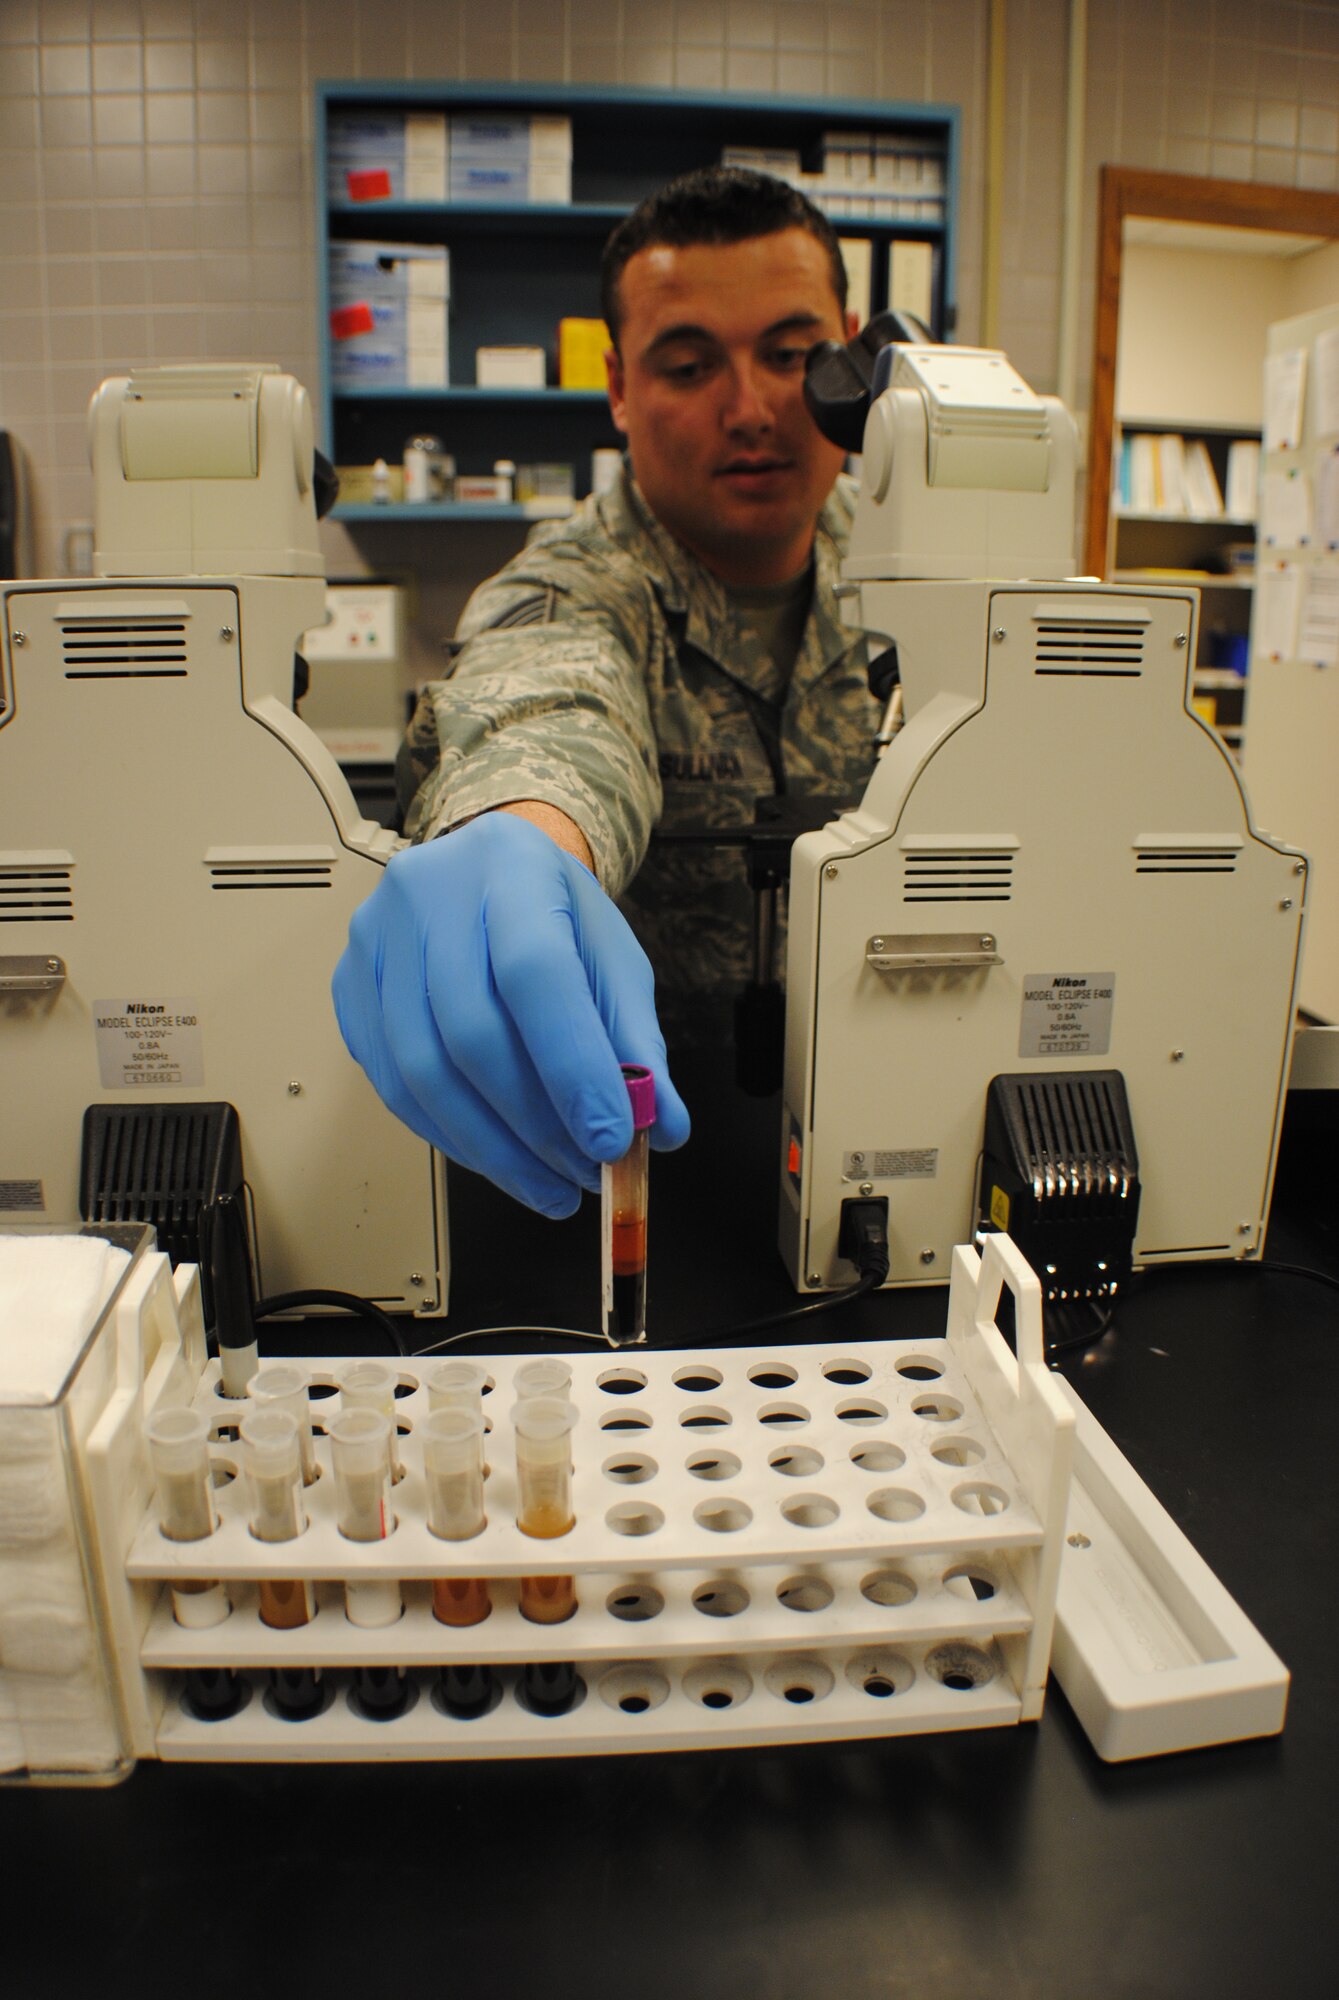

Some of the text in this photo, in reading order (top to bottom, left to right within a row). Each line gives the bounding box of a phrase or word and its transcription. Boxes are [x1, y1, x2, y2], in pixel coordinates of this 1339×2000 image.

[1052, 978, 1087, 987] Nikon
[1025, 989, 1112, 1001] MODEL ECLIPSE E400
[126, 1004, 165, 1014] Nikon
[97, 1015, 197, 1028] MODEL ECLIPSE E400
[138, 1041, 160, 1050] 0.8A
[132, 1053, 168, 1061] 50/60Hz
